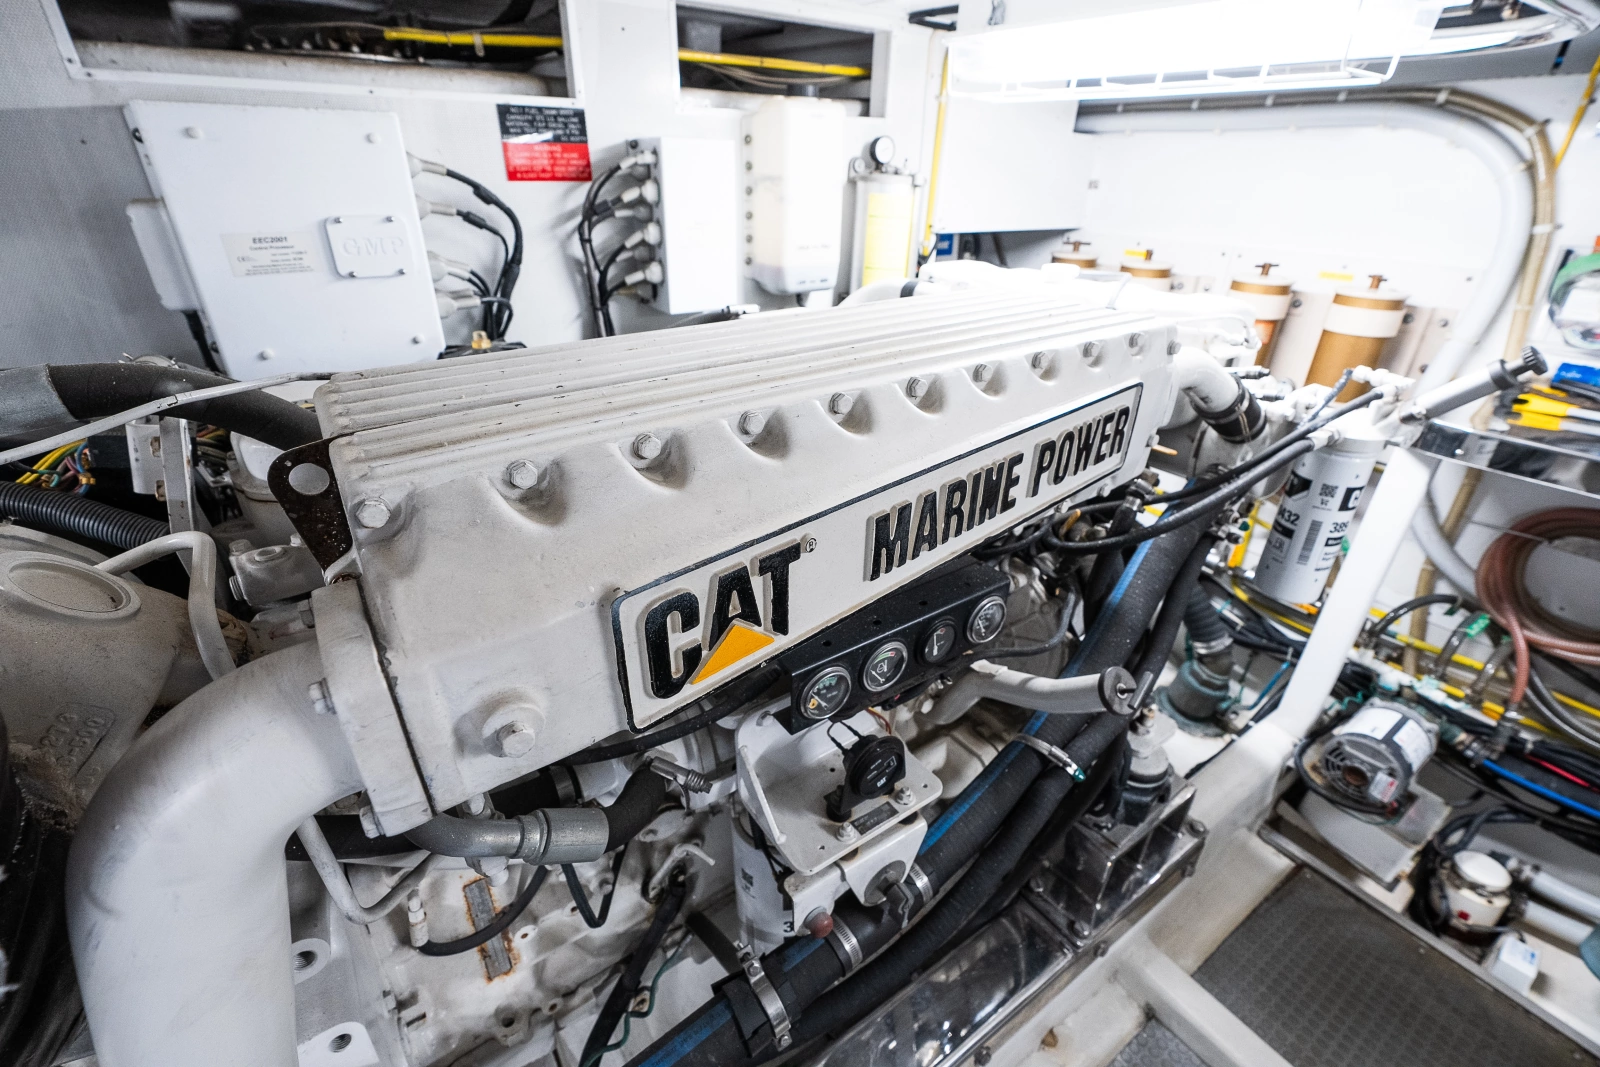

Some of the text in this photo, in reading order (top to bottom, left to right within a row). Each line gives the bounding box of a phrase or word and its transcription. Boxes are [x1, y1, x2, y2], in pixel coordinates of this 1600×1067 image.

[252, 236, 288, 244] EEC2001
[644, 405, 1131, 700] CAT MARINE POWER
